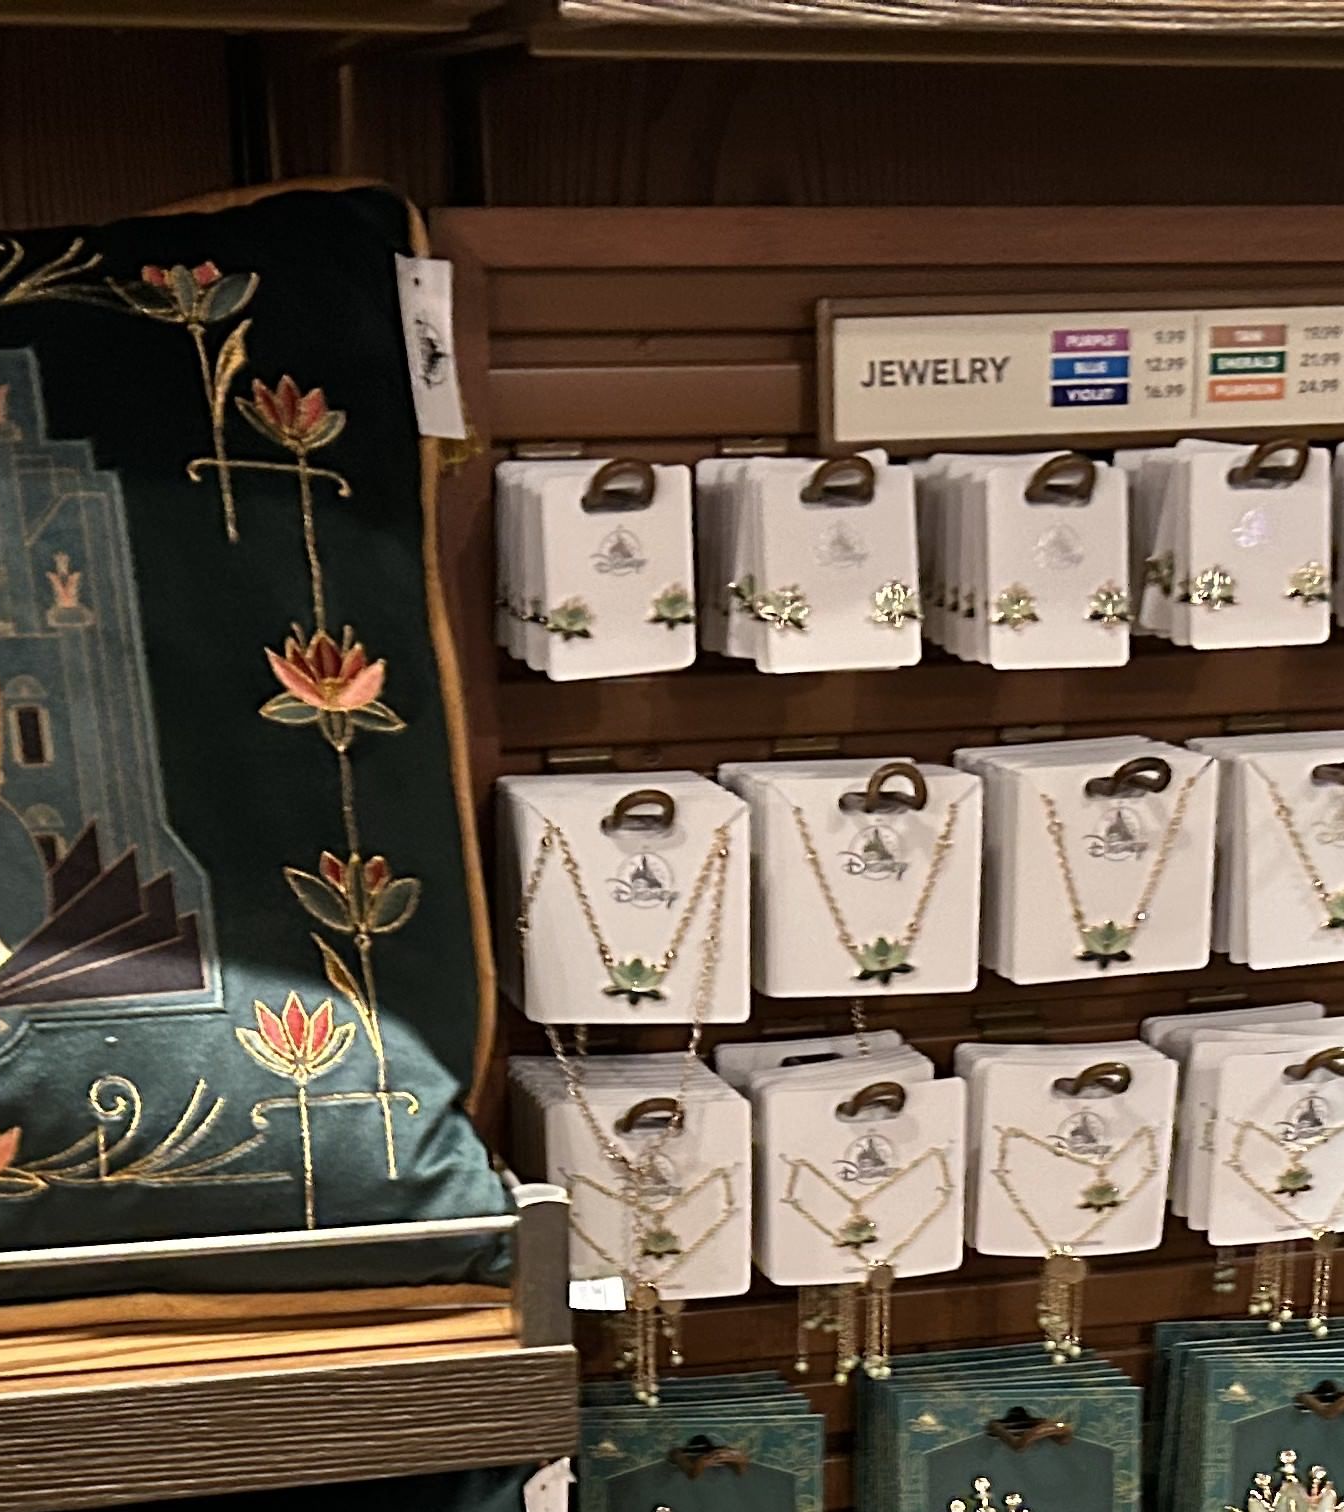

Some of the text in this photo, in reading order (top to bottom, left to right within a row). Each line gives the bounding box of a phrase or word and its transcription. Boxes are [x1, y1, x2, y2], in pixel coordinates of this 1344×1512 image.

[1065, 335, 1118, 347] PURPLE
[861, 356, 1011, 388] JEWELRY
[1146, 358, 1186, 372] 12.99
[1082, 834, 1149, 860] Disney
[837, 851, 908, 881] Disney
[605, 877, 679, 909] Disney
